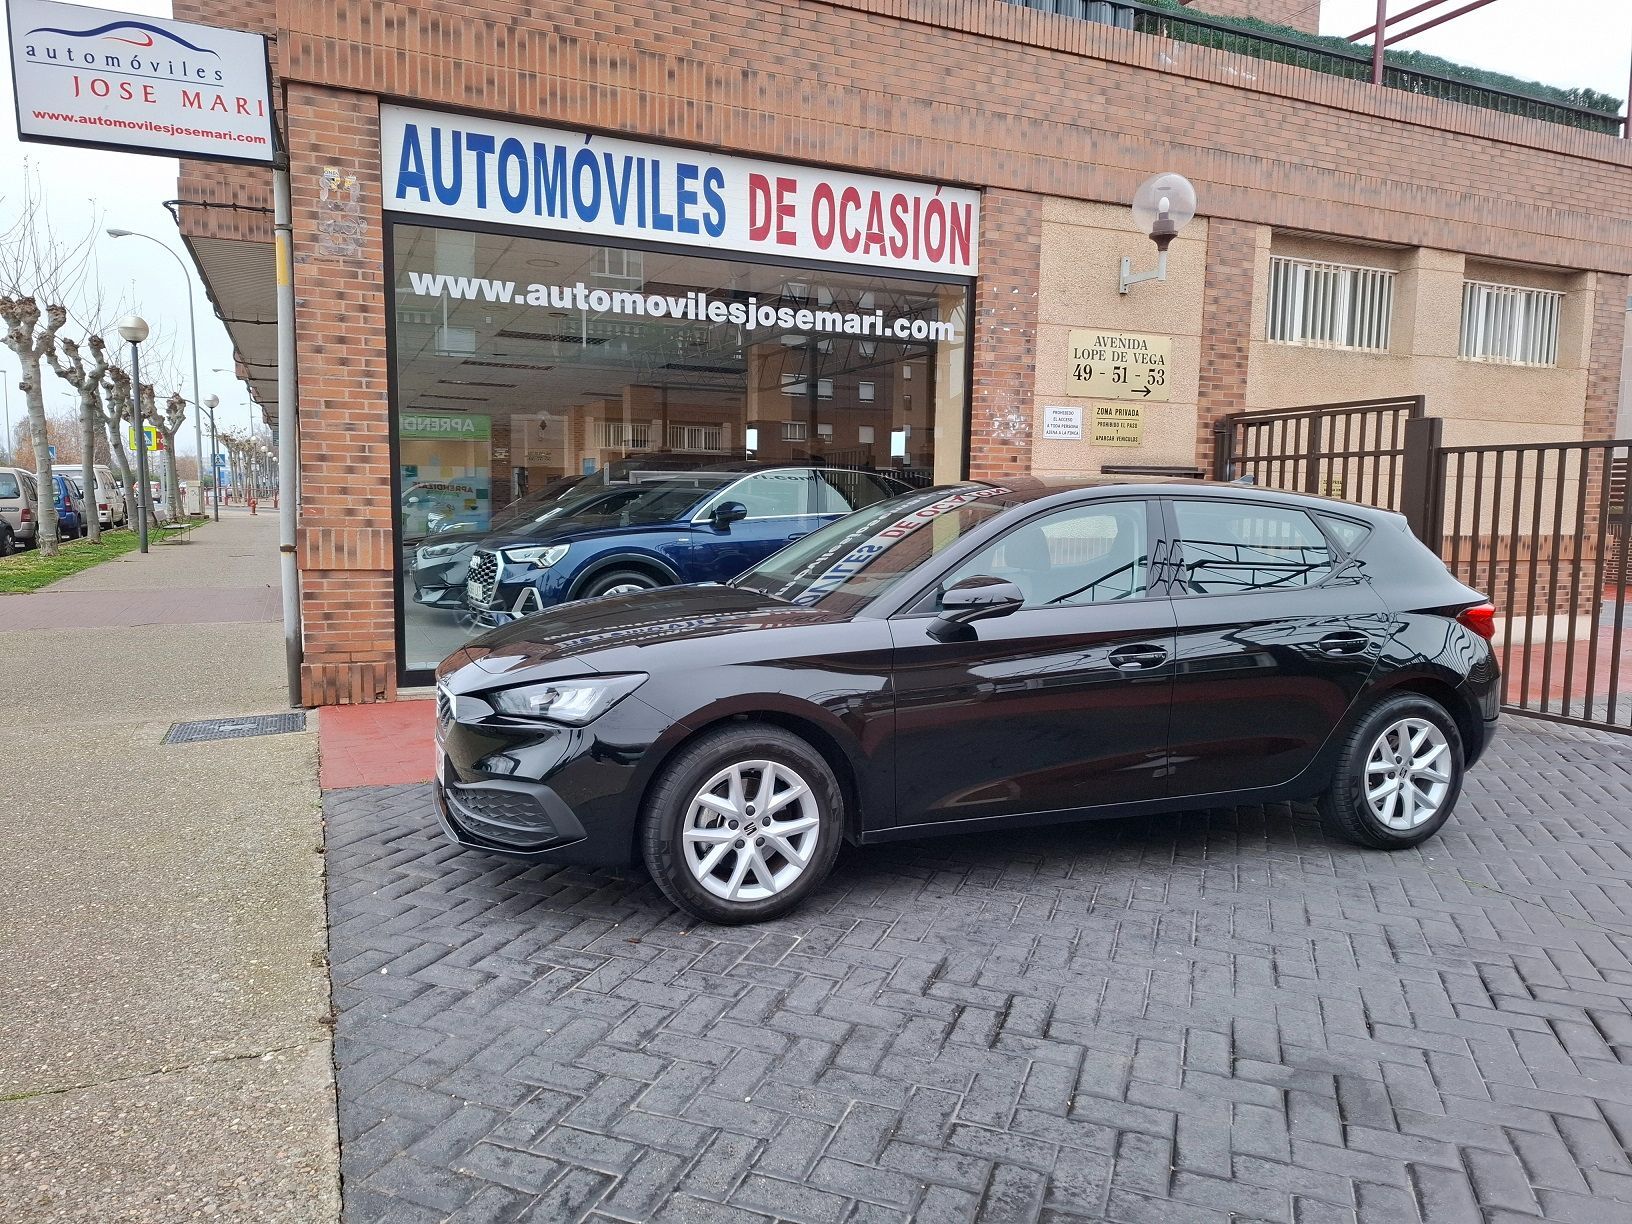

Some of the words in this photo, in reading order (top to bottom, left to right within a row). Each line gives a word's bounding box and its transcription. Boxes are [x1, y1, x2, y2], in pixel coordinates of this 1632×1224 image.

[26, 44, 223, 81] automóviles
[72, 75, 157, 103] JOSE
[181, 89, 264, 117] MARI
[32, 110, 266, 144] www.automovilesjosemari.com
[395, 123, 726, 238] AUTOMÓVILES
[748, 172, 797, 246] DE
[811, 182, 972, 266] OCASIÓN
[408, 271, 955, 342] www.automovilesjosemari.com
[1074, 348, 1106, 361] LOPE
[1111, 351, 1128, 363] DE
[1133, 352, 1165, 365] VEGA
[1094, 335, 1148, 350] AVENIDA
[1073, 364, 1093, 381] 49
[1112, 366, 1128, 384] 51
[1147, 369, 1165, 386] 53
[1097, 407, 1112, 415] ZONA
[1115, 408, 1139, 417] PRIVADA
